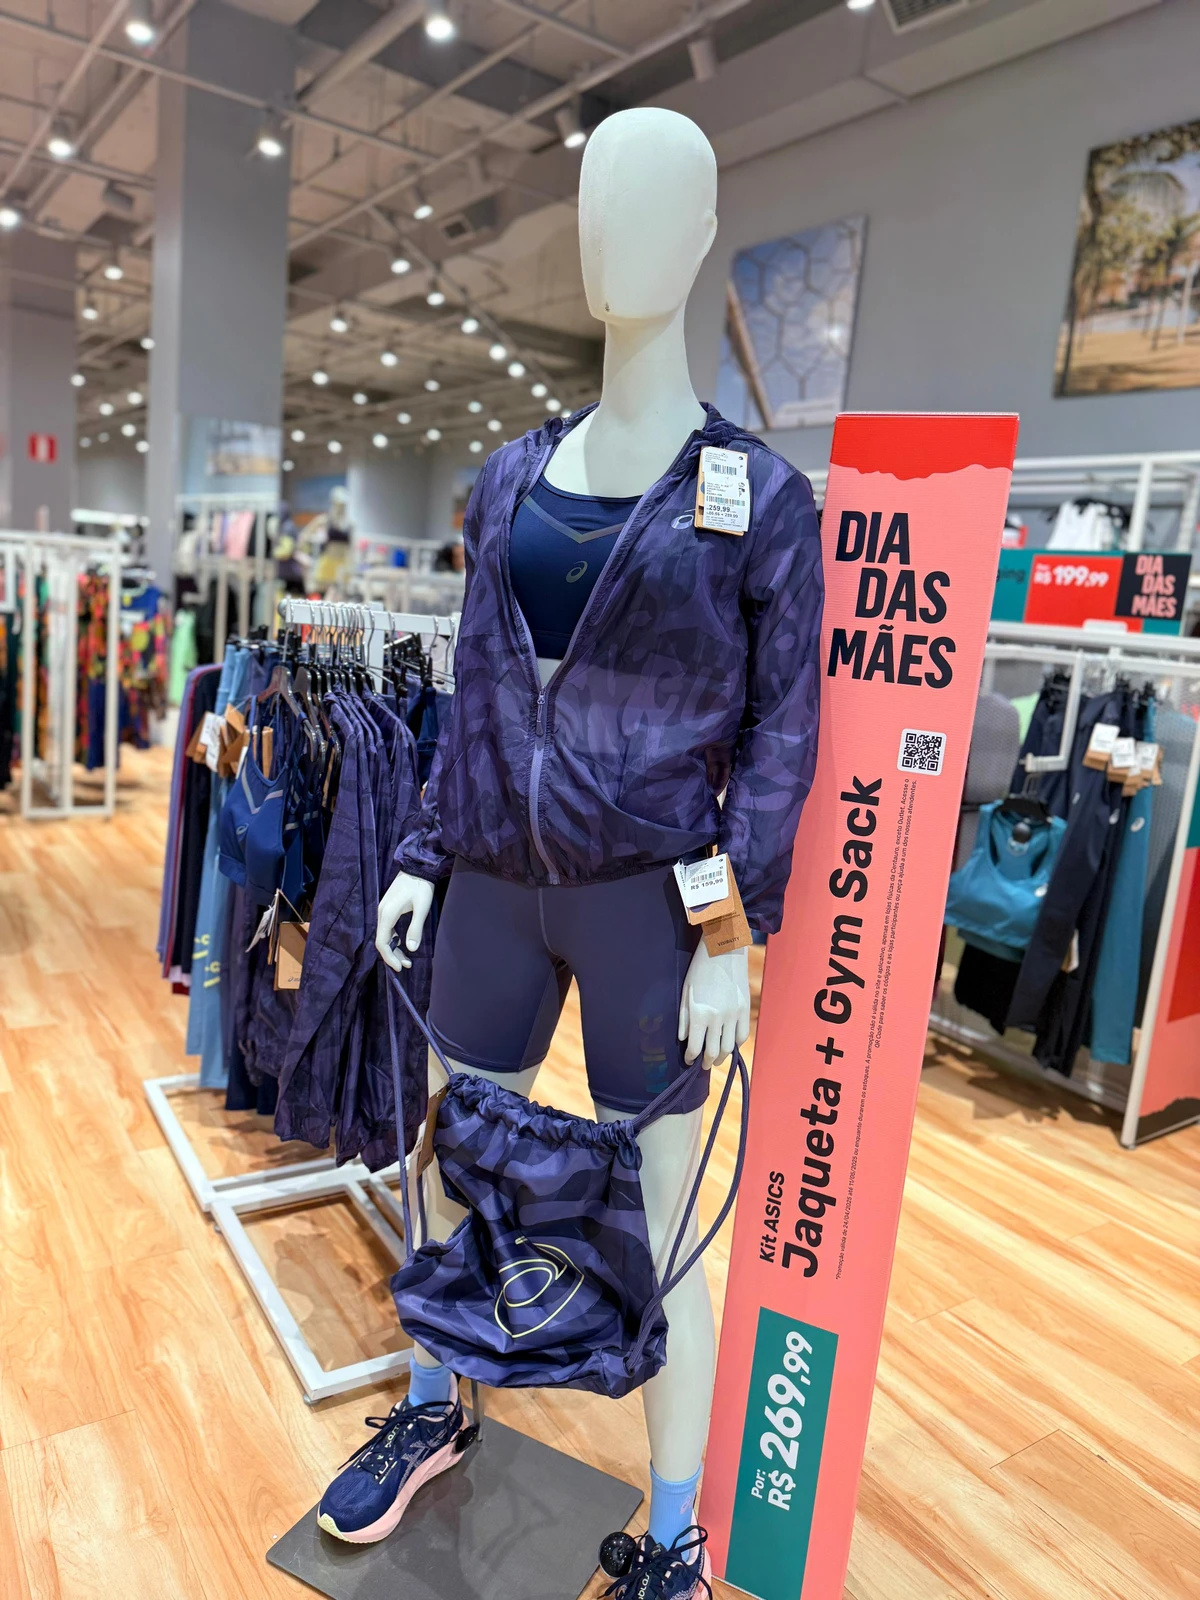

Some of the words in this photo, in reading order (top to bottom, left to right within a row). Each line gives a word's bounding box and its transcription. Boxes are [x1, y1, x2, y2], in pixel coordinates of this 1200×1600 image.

[835, 511, 910, 565] DIA
[1135, 555, 1164, 575] DIA
[855, 567, 950, 624] DAS
[1053, 565, 1109, 587] 199,99
[1141, 574, 1176, 595] DAS
[827, 624, 956, 689] MÃES
[829, 775, 882, 902] Sack
[883, 966, 891, 987] códigos
[891, 902, 899, 939] participantes
[908, 780, 916, 814] atendentes.
[813, 914, 865, 1025] Gym
[815, 1036, 844, 1065] +
[763, 1170, 785, 1233] ASICS
[781, 1077, 842, 1278] Jaqueta
[759, 1233, 777, 1263] Kit
[759, 1331, 812, 1470] 269,99
[751, 1468, 767, 1499] Por:
[767, 1469, 796, 1511] R$
